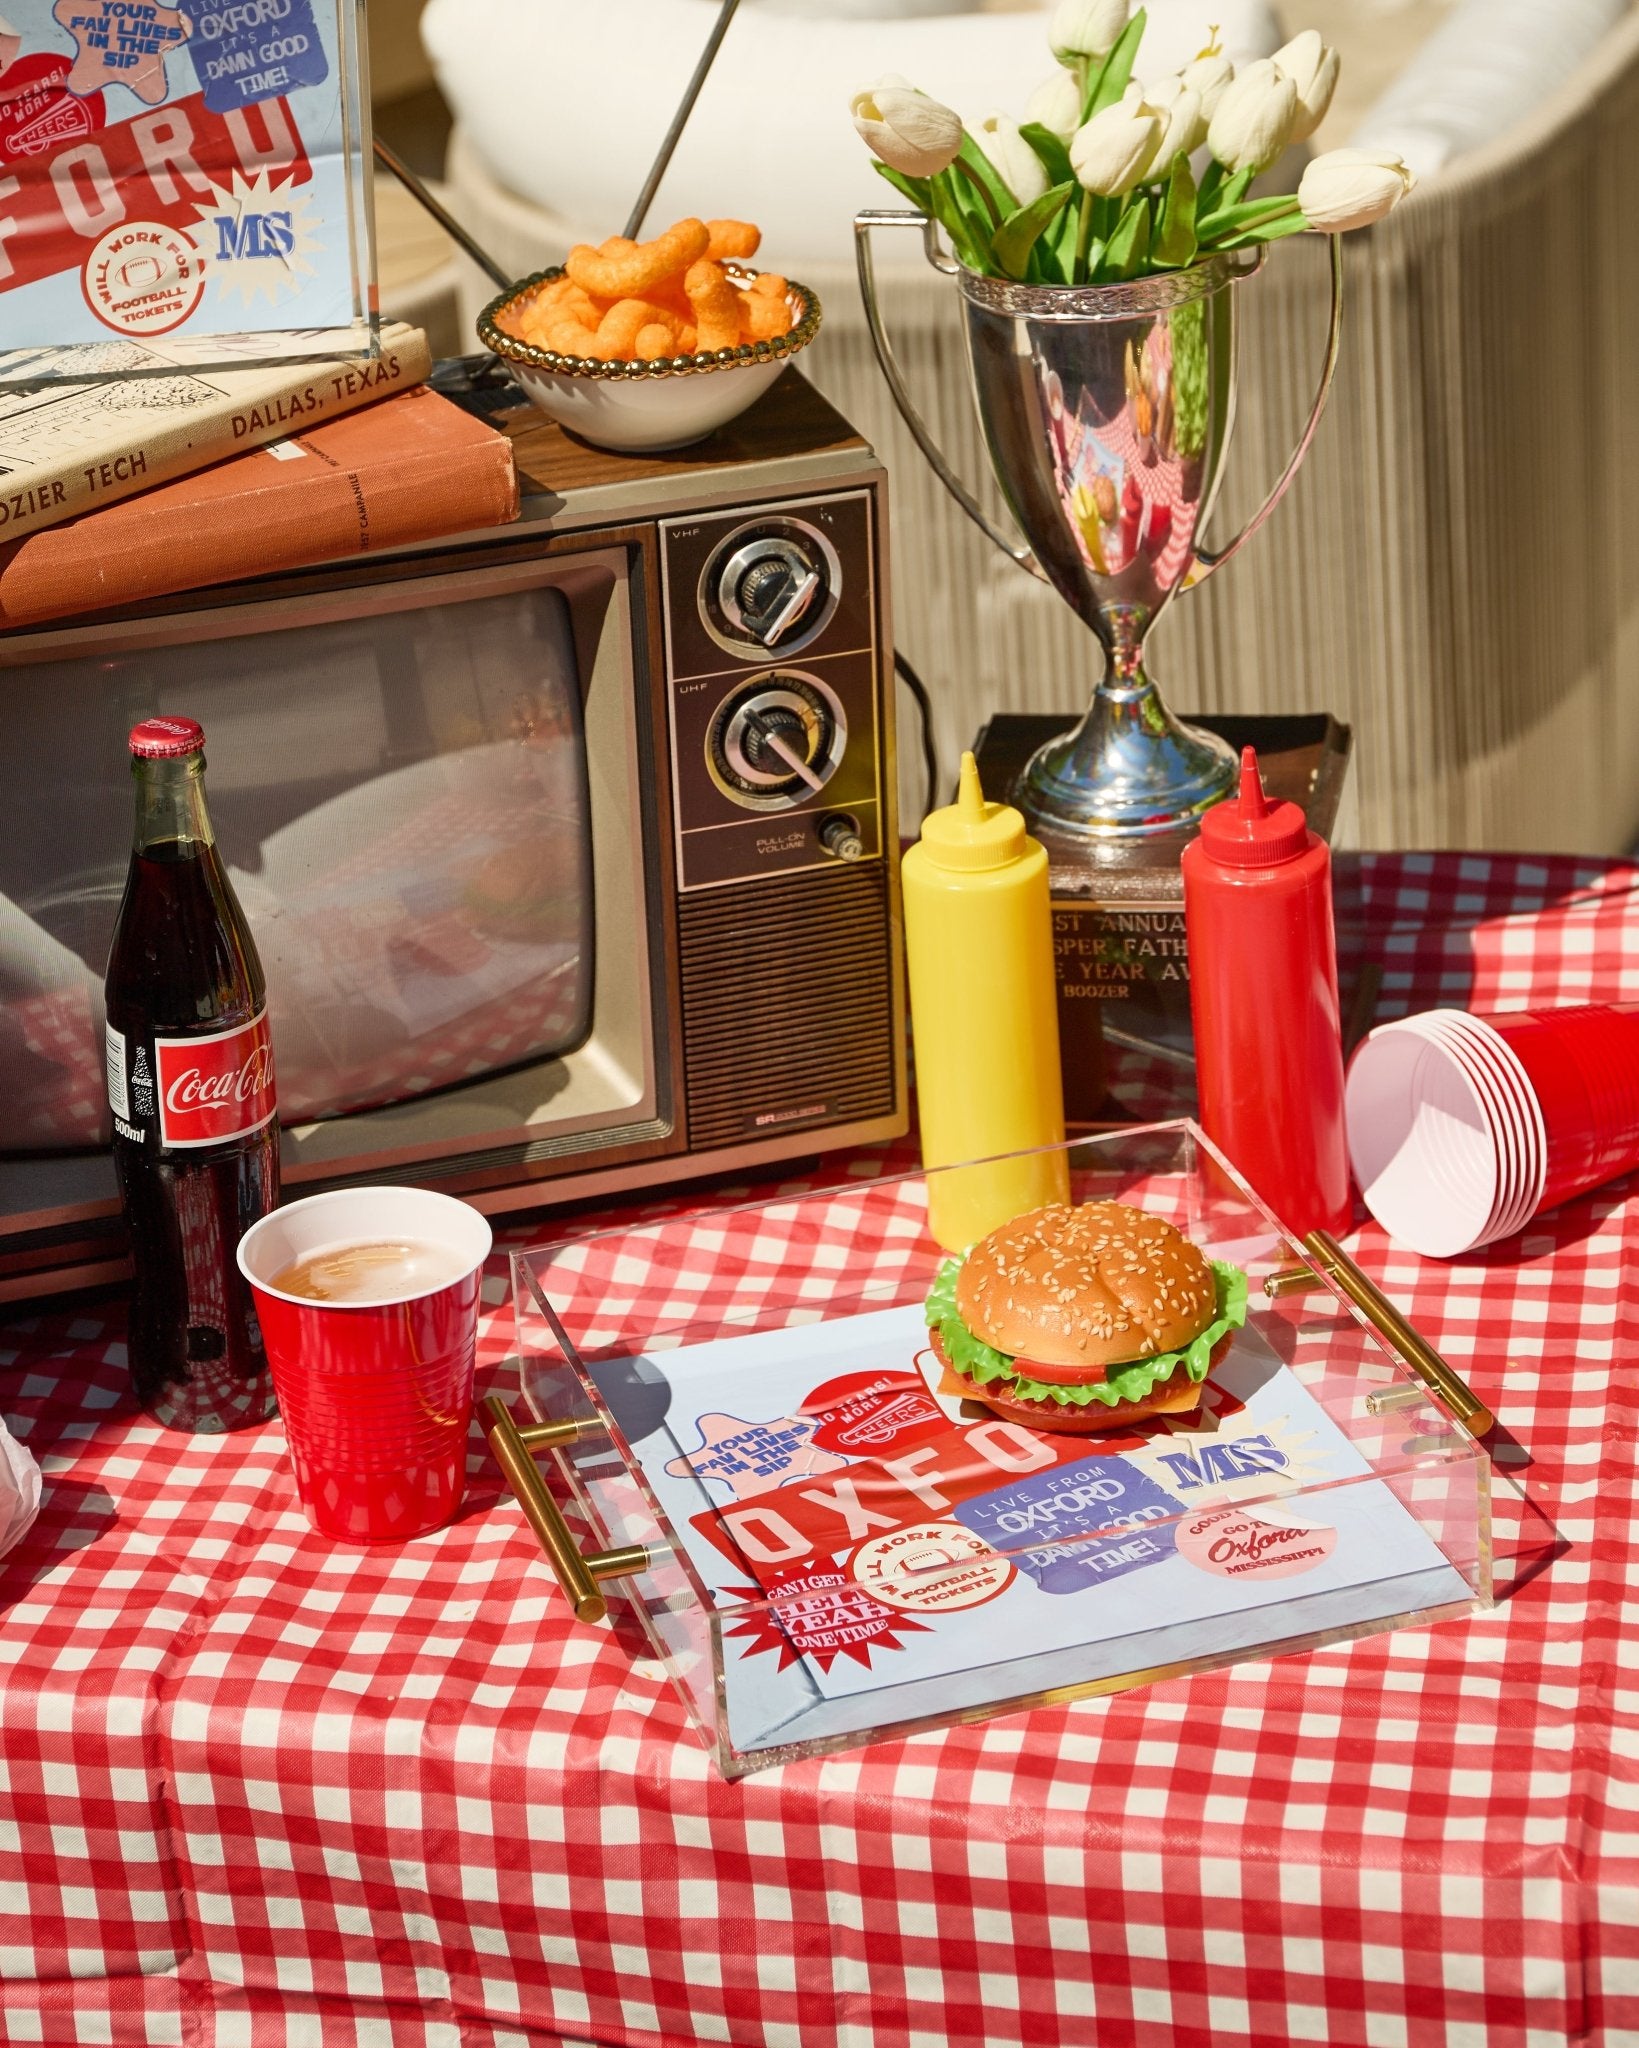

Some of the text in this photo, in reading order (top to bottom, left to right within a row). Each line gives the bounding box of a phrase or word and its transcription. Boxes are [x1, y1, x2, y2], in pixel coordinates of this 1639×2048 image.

[102, 2, 157, 21] YOUR
[200, 0, 291, 40] OXFORD
[70, 17, 181, 40] FAV LIVES
[220, 25, 280, 53] IT'S A
[87, 33, 160, 54] IN THE
[206, 35, 308, 80] DAMN GOOD
[103, 52, 139, 68] SIP
[16, 66, 64, 105] TEARS!
[234, 66, 289, 95] TIME!
[14, 91, 50, 123] MORE
[18, 110, 78, 145] CHEERS
[214, 211, 295, 262] MS
[96, 231, 189, 304] WILL WORK FOR
[111, 287, 187, 312] FOOTBALL
[121, 301, 183, 323] TICKETS
[84, 451, 147, 492] TECH
[231, 388, 323, 439] DALLAS,
[331, 356, 400, 399] TEXAS
[348, 473, 369, 528] CAMPANILE
[672, 528, 700, 539] VHF
[680, 683, 707, 693] UHF
[756, 832, 805, 846] PULL-ON
[757, 840, 805, 854] VOLUME
[1055, 914, 1187, 932] ST ANNUA
[1053, 938, 1189, 956] SPER FATH
[1080, 962, 1145, 979] YEAR
[1063, 985, 1130, 998] BOOZER
[166, 1036, 273, 1114] Coca-Cola
[115, 1117, 146, 1144] 500ml
[835, 1377, 893, 1413] TEARS!
[840, 1397, 882, 1424] MORE
[855, 1404, 926, 1438] CHEERS
[693, 1423, 810, 1475] FAV LIVES
[707, 1427, 772, 1455] YOUR
[721, 1440, 802, 1476] IN THE
[753, 1456, 792, 1477] SIP
[1155, 1435, 1290, 1490] MS
[716, 1423, 1058, 1563] OXFO
[974, 1466, 1106, 1518] LIVE FROM
[996, 1479, 1126, 1533] OXFORD
[1034, 1505, 1122, 1540] IT'S A
[1099, 1505, 1170, 1540] GOOD
[1189, 1511, 1232, 1535] GOOD
[1222, 1525, 1249, 1535] GO
[874, 1531, 942, 1555] WORK
[1078, 1537, 1161, 1572] TIME!
[1225, 1547, 1326, 1575] MISSISSIPPI
[766, 1583, 800, 1600] CAN
[808, 1574, 845, 1589] GET
[867, 1560, 900, 1596] WLL
[901, 1566, 997, 1600] FOOTBALL
[918, 1576, 997, 1605] TICKETS
[768, 1602, 895, 1636] YEAH
[769, 1589, 870, 1621] HEL
[792, 1619, 889, 1648] ONE TIME
